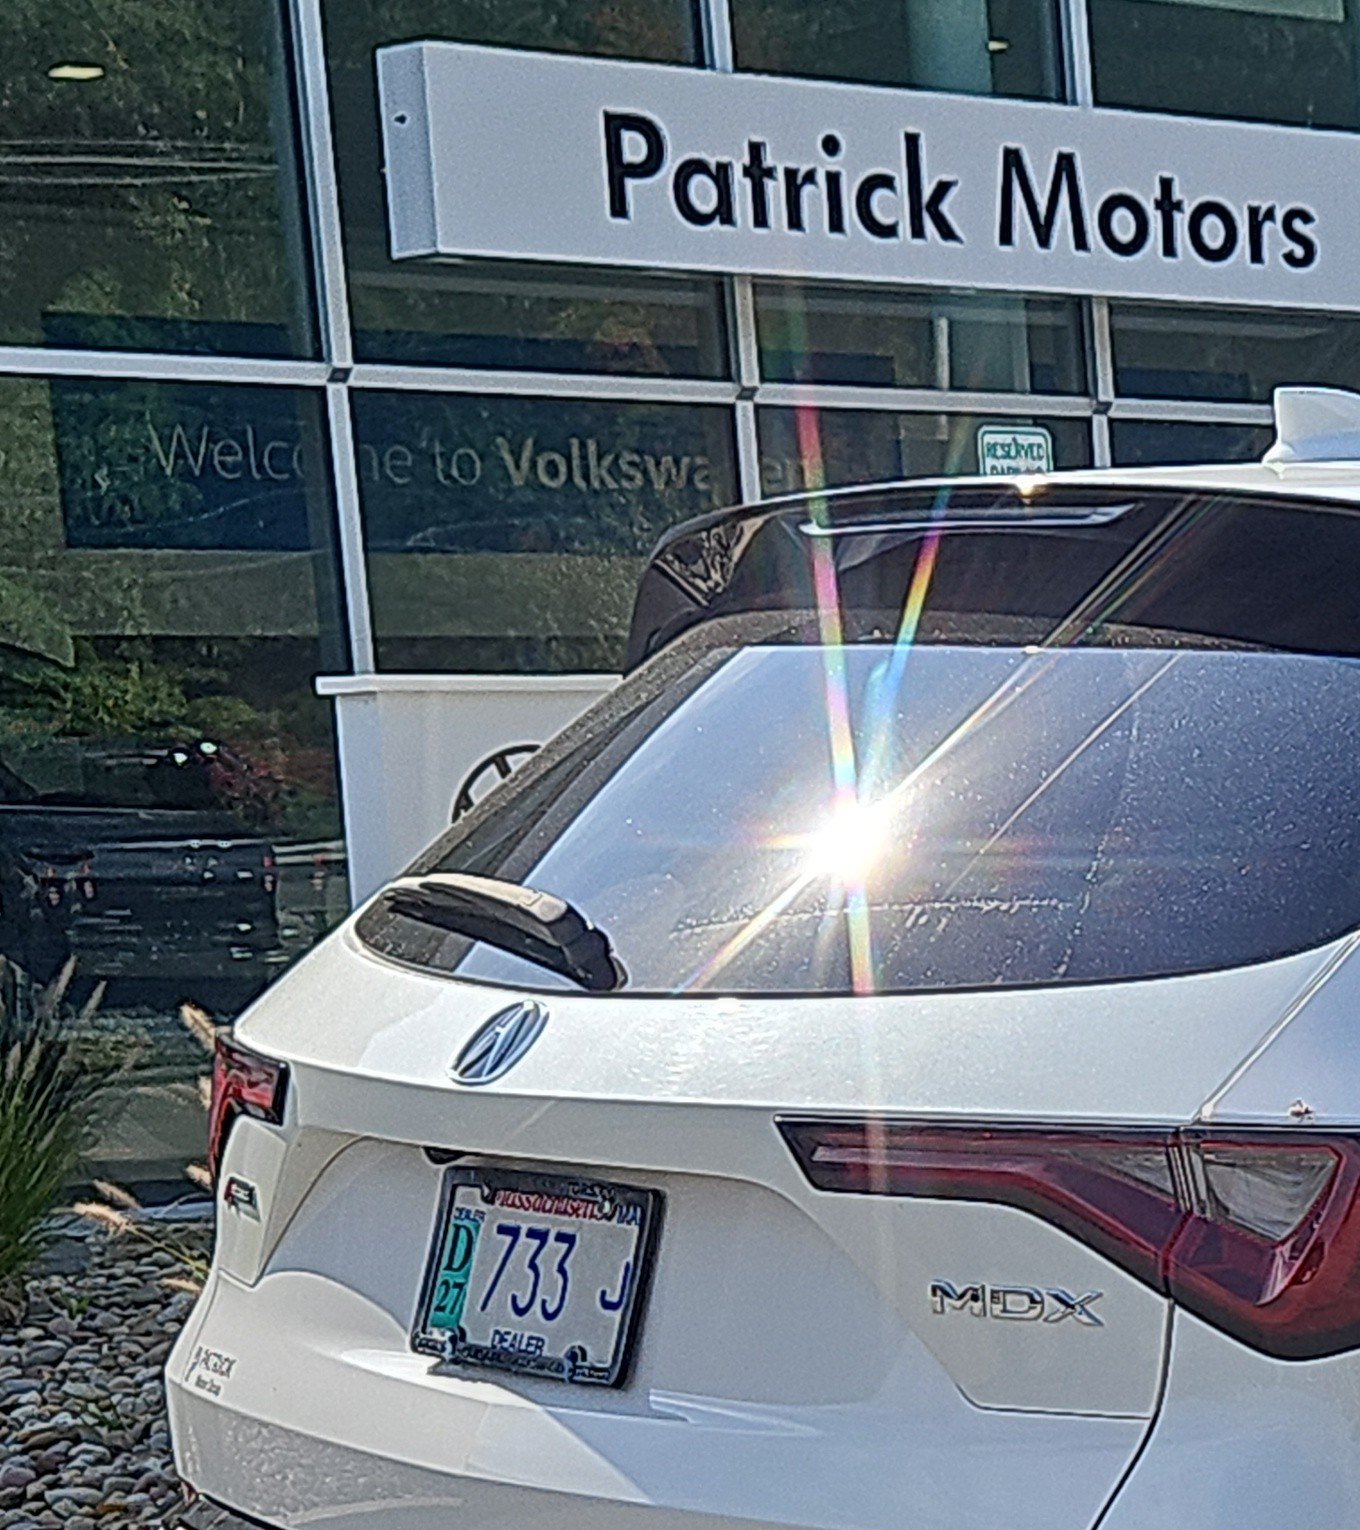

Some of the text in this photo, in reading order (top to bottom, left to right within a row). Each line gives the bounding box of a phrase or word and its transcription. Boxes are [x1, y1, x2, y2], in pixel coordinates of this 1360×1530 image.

[602, 109, 1319, 270] Patrick Motors
[149, 422, 413, 484] Welce
[434, 437, 478, 485] to
[443, 1223, 474, 1273] D
[480, 1223, 631, 1322] 733 J
[433, 1279, 467, 1313] 27
[930, 1278, 1104, 1327] MDX
[491, 1329, 546, 1357] DEALER
